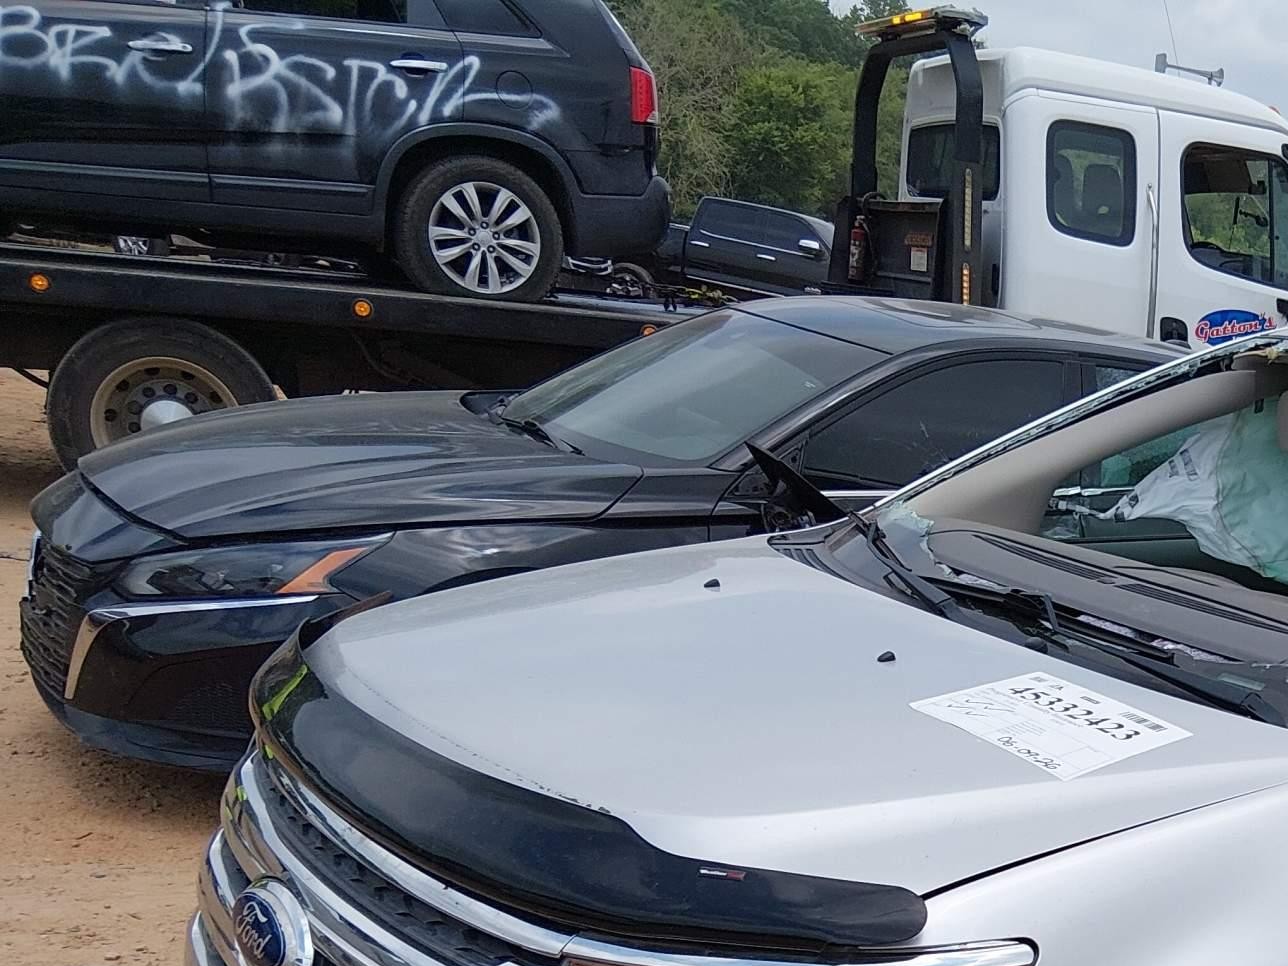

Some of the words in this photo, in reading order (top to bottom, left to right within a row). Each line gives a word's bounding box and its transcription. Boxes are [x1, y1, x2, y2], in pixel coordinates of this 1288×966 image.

[1195, 312, 1277, 343] Gatton's
[1008, 687, 1141, 740] 45332423
[235, 901, 273, 959] Ford
